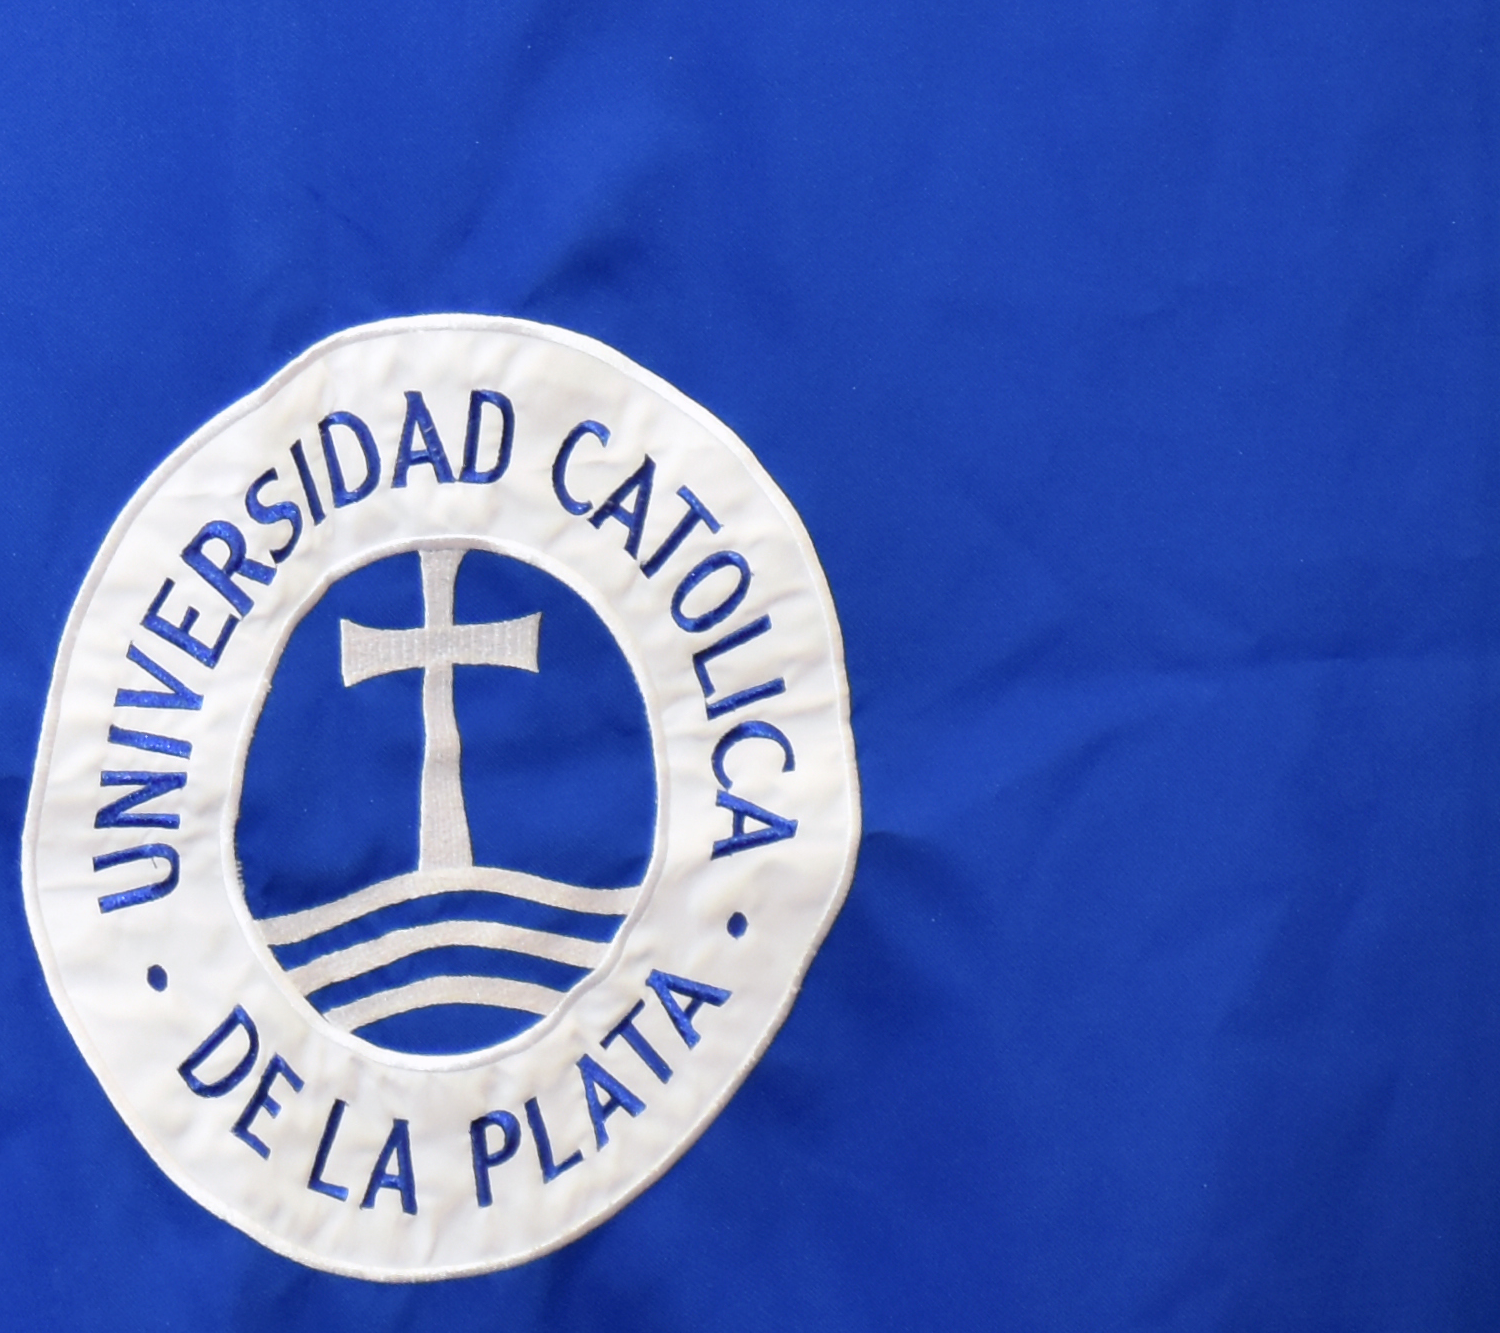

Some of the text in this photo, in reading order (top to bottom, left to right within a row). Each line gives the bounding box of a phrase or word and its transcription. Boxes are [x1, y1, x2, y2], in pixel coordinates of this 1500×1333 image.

[93, 388, 800, 914] UNIVERSIDAD CATOLICA
[175, 966, 733, 1216] DE LA PLATA
